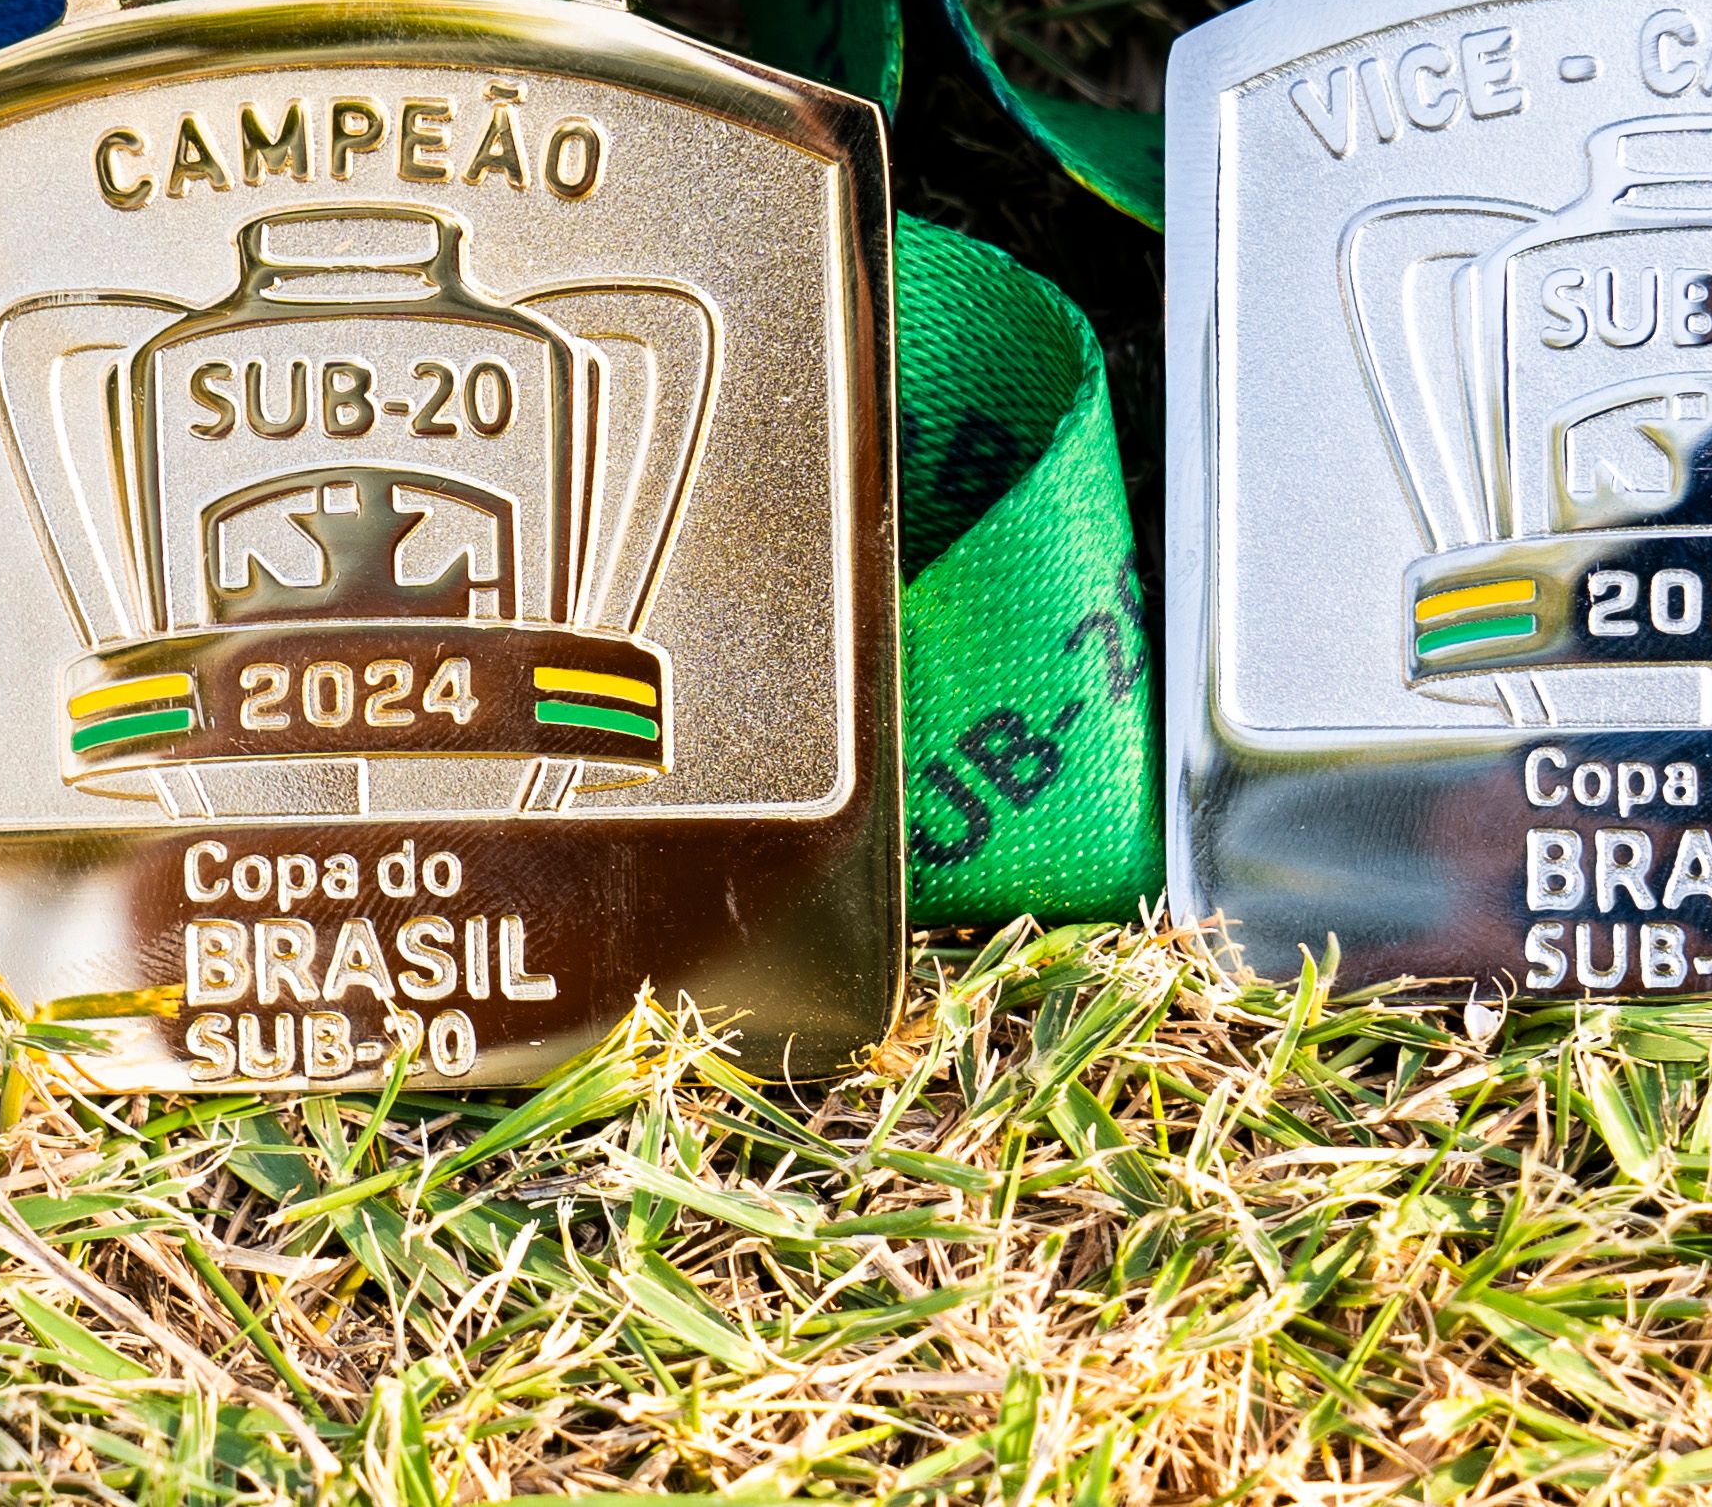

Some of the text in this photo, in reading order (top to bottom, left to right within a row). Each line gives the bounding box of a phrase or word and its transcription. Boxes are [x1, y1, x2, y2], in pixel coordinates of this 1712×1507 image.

[1289, 24, 1521, 159] VICE
[93, 81, 608, 210] CAMPEÃO
[185, 355, 515, 441] SUB-20
[237, 656, 481, 732] 2024
[1522, 745, 1700, 818] Copa
[182, 837, 463, 914] Copa do
[182, 915, 559, 1006] BRASIL
[182, 1011, 480, 1082] SUB-20
